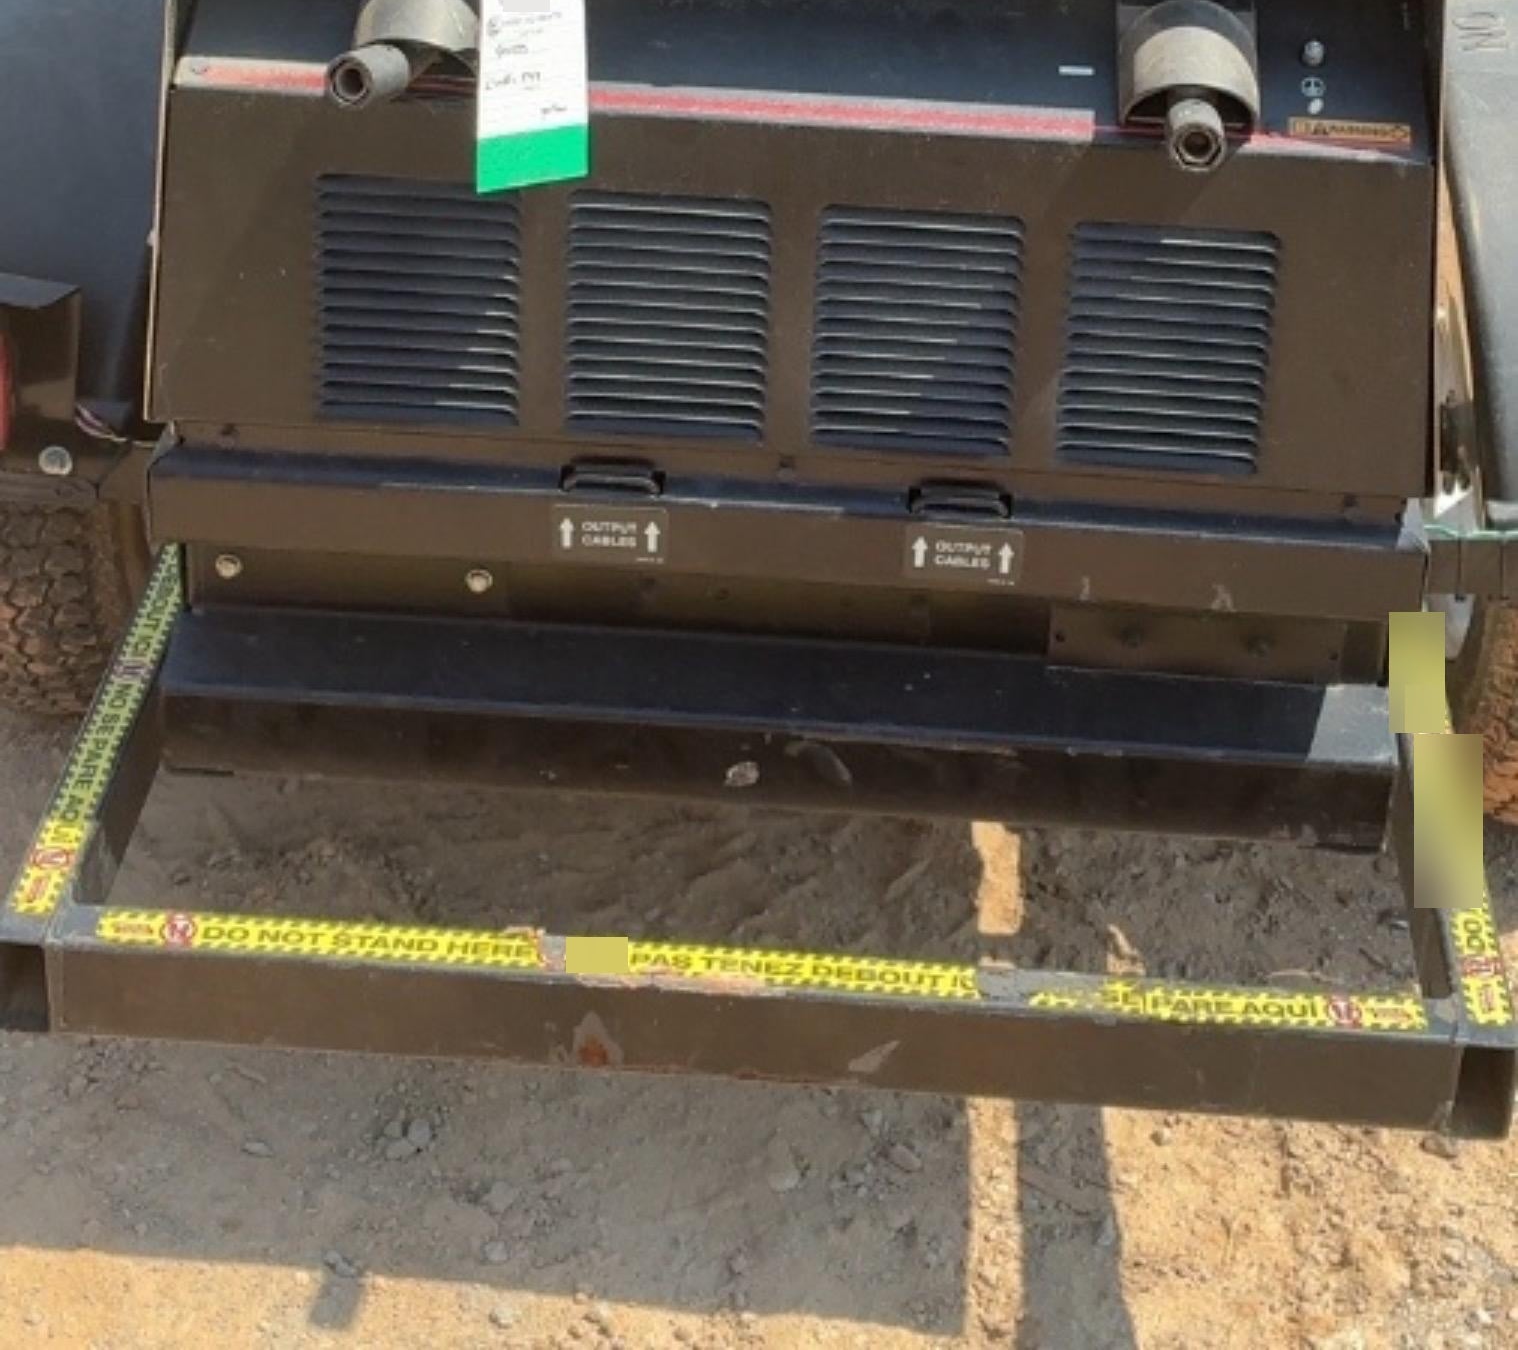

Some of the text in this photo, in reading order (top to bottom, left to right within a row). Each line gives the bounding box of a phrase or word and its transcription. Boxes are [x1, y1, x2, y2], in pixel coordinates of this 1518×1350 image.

[581, 521, 638, 535] OUTPUT
[581, 535, 638, 548] CABLES
[935, 540, 992, 556] OUTPUT
[934, 554, 991, 570] CABLES
[107, 683, 133, 709] NO
[72, 737, 109, 791] PARE
[201, 924, 533, 961] DO NOT STAND HERE
[629, 950, 693, 972] PAS
[702, 954, 805, 977] TENEZ
[811, 961, 944, 989] DEBOUT
